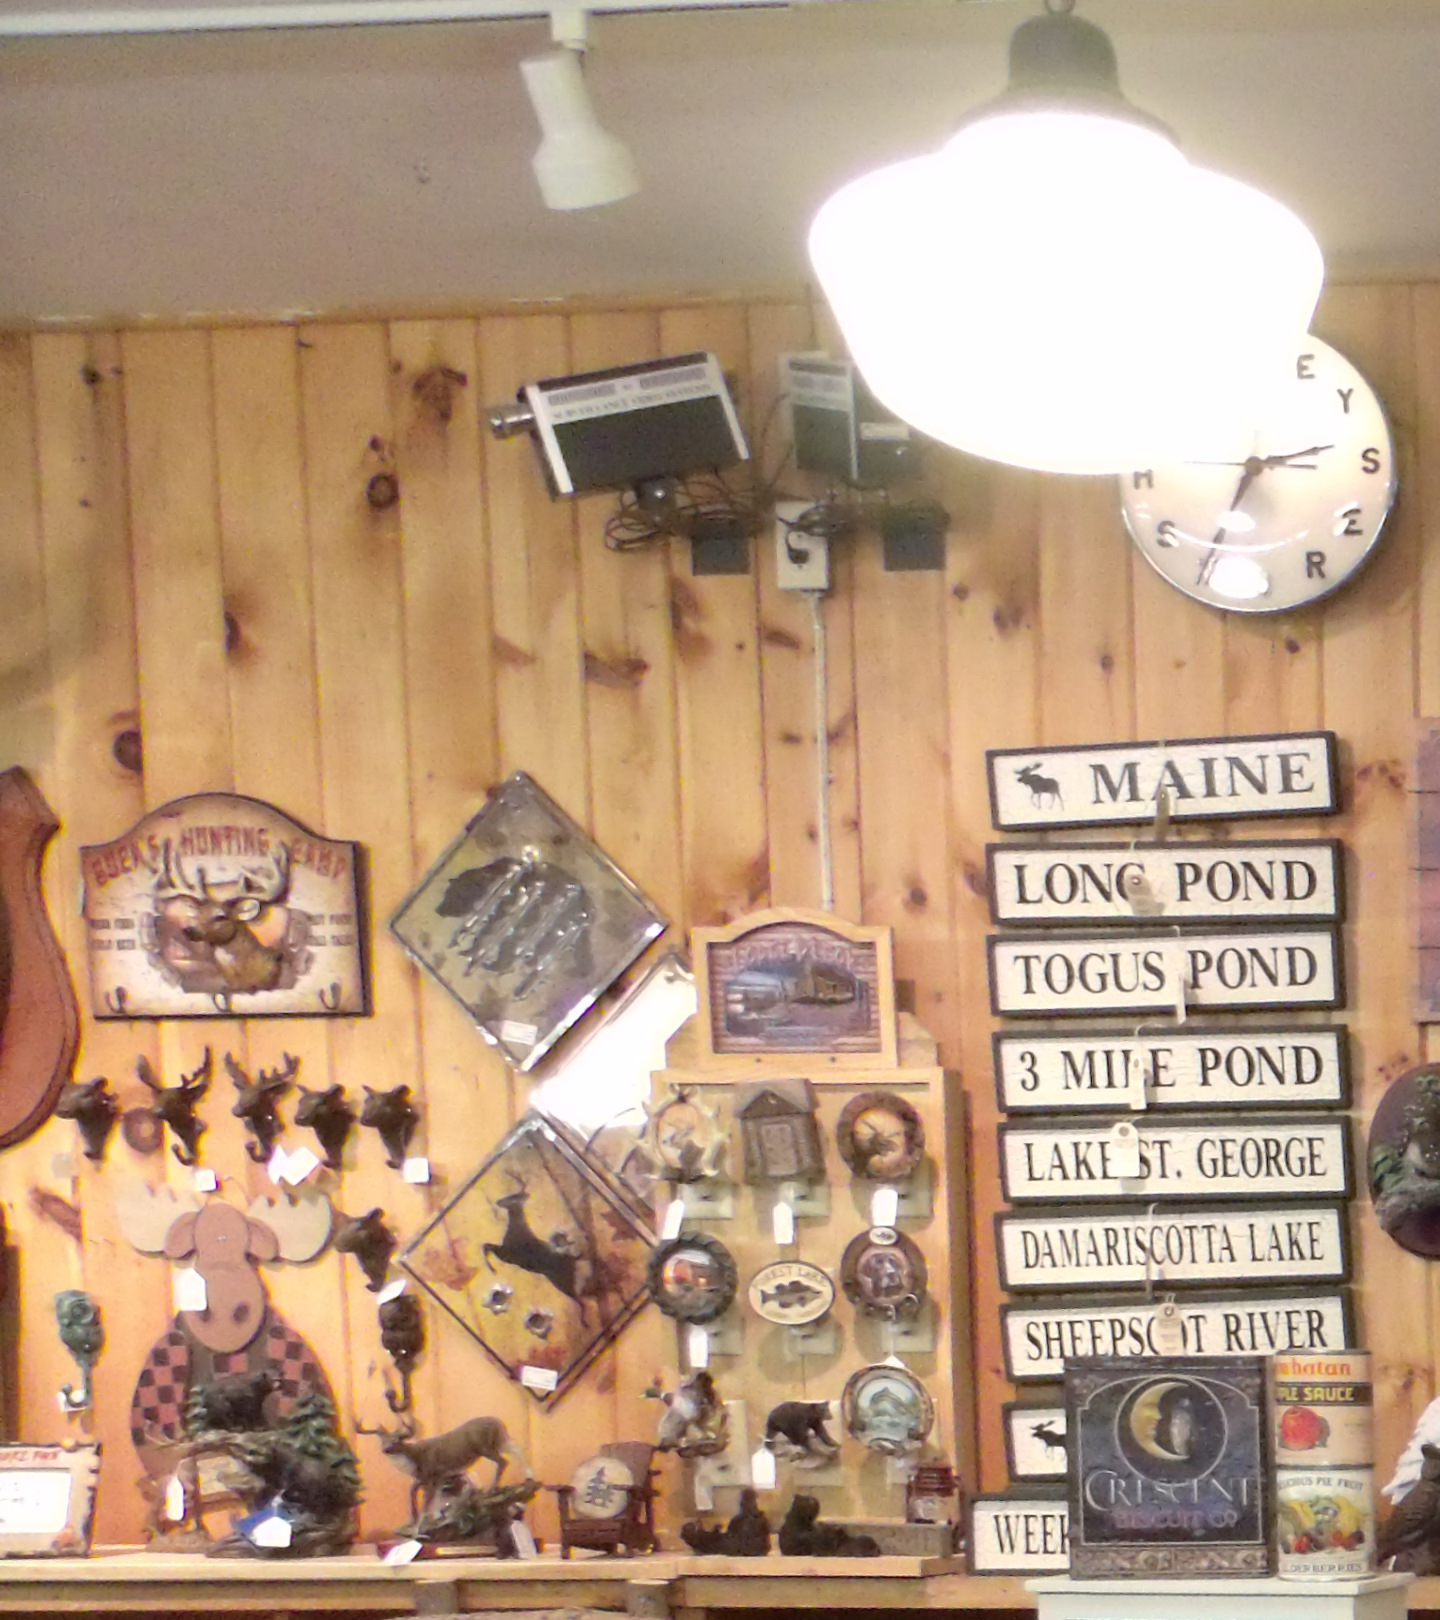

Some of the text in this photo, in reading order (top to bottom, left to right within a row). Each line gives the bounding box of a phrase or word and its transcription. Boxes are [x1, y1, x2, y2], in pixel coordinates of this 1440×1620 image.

[1089, 751, 1316, 805] MAINE
[1176, 860, 1318, 904] POND
[1013, 946, 1318, 996] TOGUS POND
[1019, 1050, 1041, 1093] 3
[1199, 1045, 1324, 1088] POND
[1197, 1136, 1327, 1179] GEORGE
[1021, 1220, 1325, 1270] DAMARISCOTTA LAKE
[1025, 1308, 1329, 1362] SHEEPSCT RIVER
[1303, 1386, 1355, 1402] SAUCE
[1084, 1468, 1255, 1512] CRESCENT
